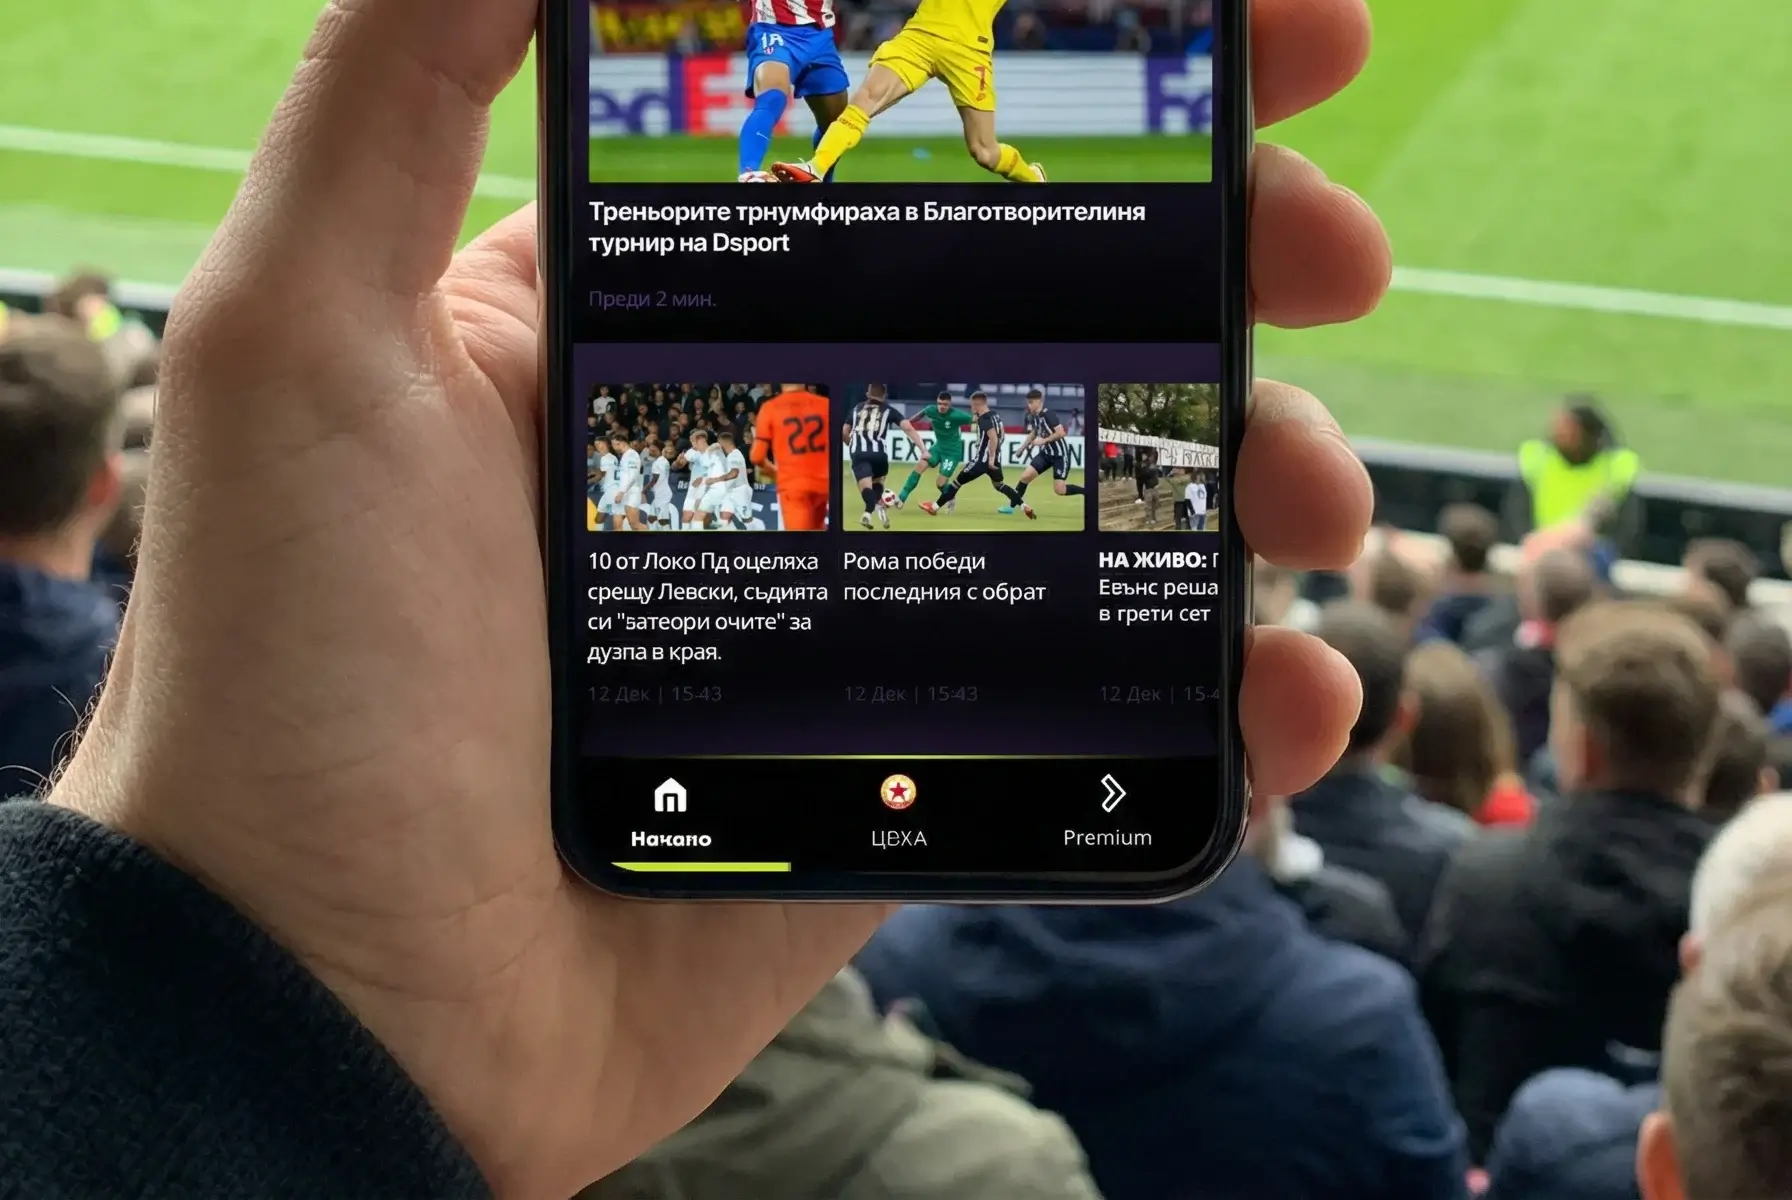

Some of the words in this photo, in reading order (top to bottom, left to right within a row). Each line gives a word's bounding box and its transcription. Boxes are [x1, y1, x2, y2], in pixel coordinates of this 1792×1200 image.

[588, 201, 731, 226] Треньорите
[905, 205, 919, 221] в
[588, 236, 675, 257] турнир
[679, 236, 708, 253] на
[713, 232, 790, 257] Dsport
[589, 290, 650, 311] Преди
[656, 290, 668, 307] 2
[672, 294, 717, 307] мин.
[783, 415, 827, 455] 22
[589, 551, 612, 570] 10
[615, 556, 640, 570] от
[642, 552, 696, 570] Локо
[701, 552, 730, 574] Пд
[733, 555, 819, 574] оцеляха
[844, 552, 899, 570] Рома
[905, 551, 986, 574] победи
[1099, 551, 1130, 568] НА
[1133, 551, 1207, 568] ЖИВО:
[587, 586, 655, 605] срещу
[657, 582, 738, 603] Левски,
[844, 586, 961, 605] последния
[967, 586, 978, 601] с
[982, 582, 1047, 606] обрат
[1164, 582, 1219, 600] реша
[587, 616, 612, 630] си
[715, 612, 785, 630] очите"
[789, 616, 812, 631] за
[1099, 608, 1111, 621] в
[1179, 608, 1211, 622] сет
[586, 646, 647, 665] дузпа
[652, 646, 664, 660] в
[669, 646, 722, 665] края.
[589, 686, 610, 701] 12
[615, 686, 650, 704] Дек
[845, 686, 866, 701] 12
[872, 686, 906, 704] Дек
[1101, 686, 1121, 701] 12
[1127, 686, 1161, 704] Дек
[1064, 829, 1152, 846] Premium
